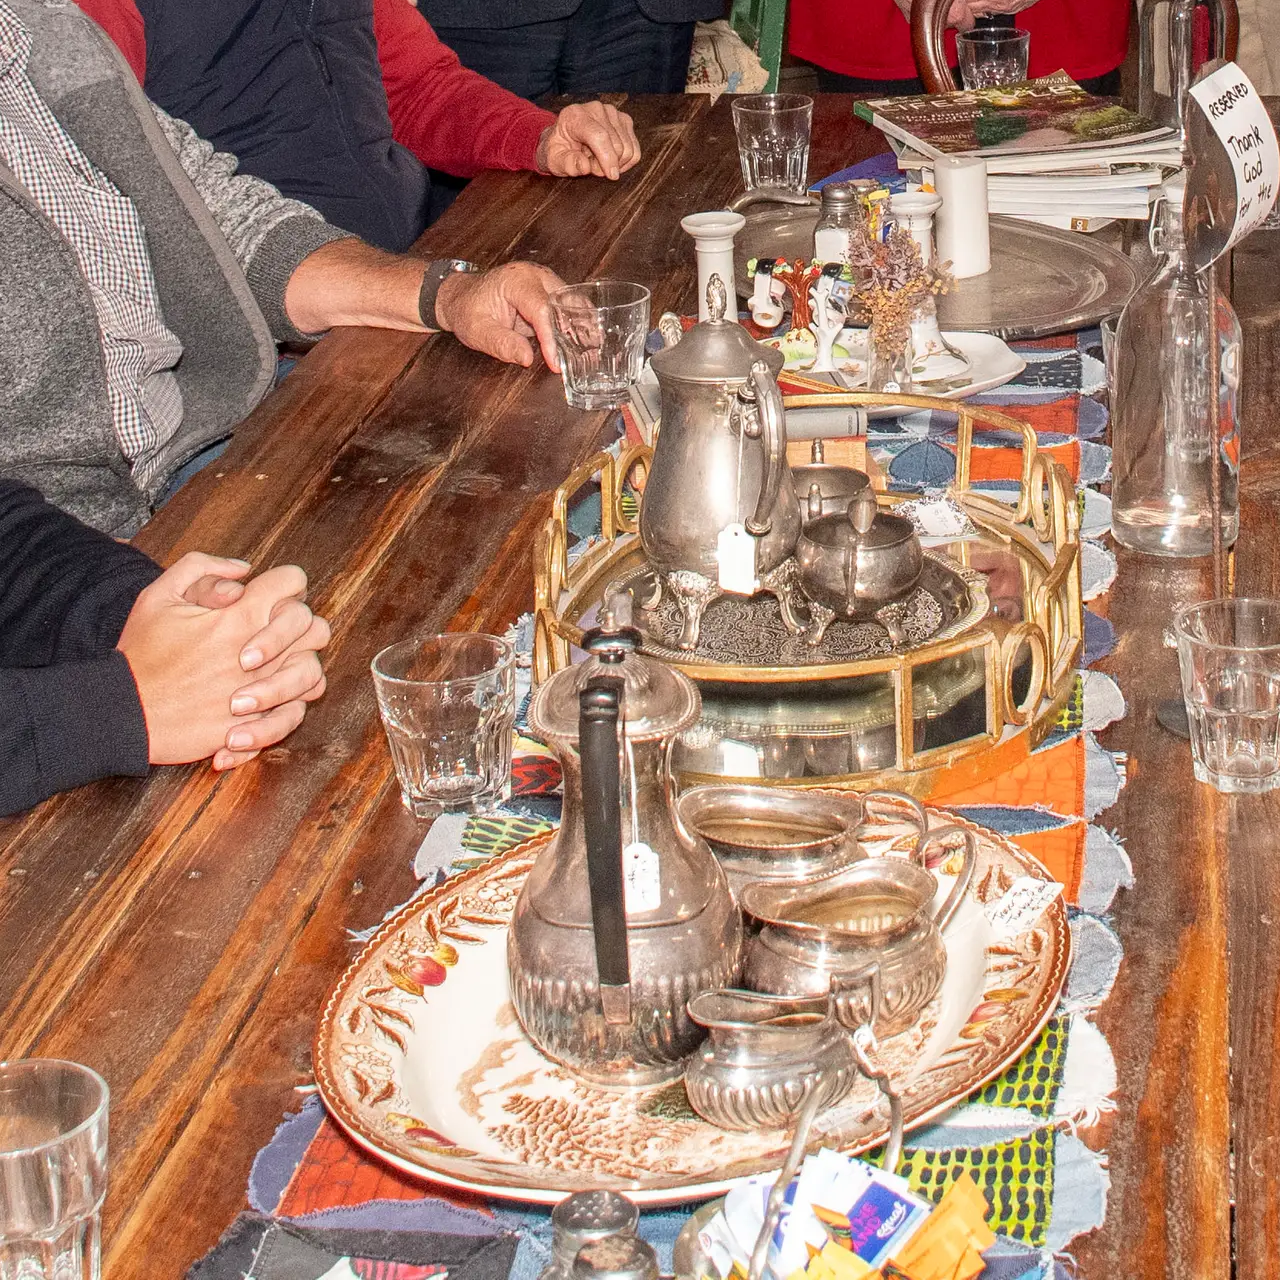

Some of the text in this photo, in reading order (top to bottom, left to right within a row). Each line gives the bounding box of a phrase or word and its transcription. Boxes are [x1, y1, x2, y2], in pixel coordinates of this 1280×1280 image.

[1208, 83, 1249, 120] RESERVED
[1227, 124, 1264, 158] Thank
[1243, 151, 1263, 184] God
[1239, 182, 1272, 218] for the
[876, 1201, 907, 1239] equal
